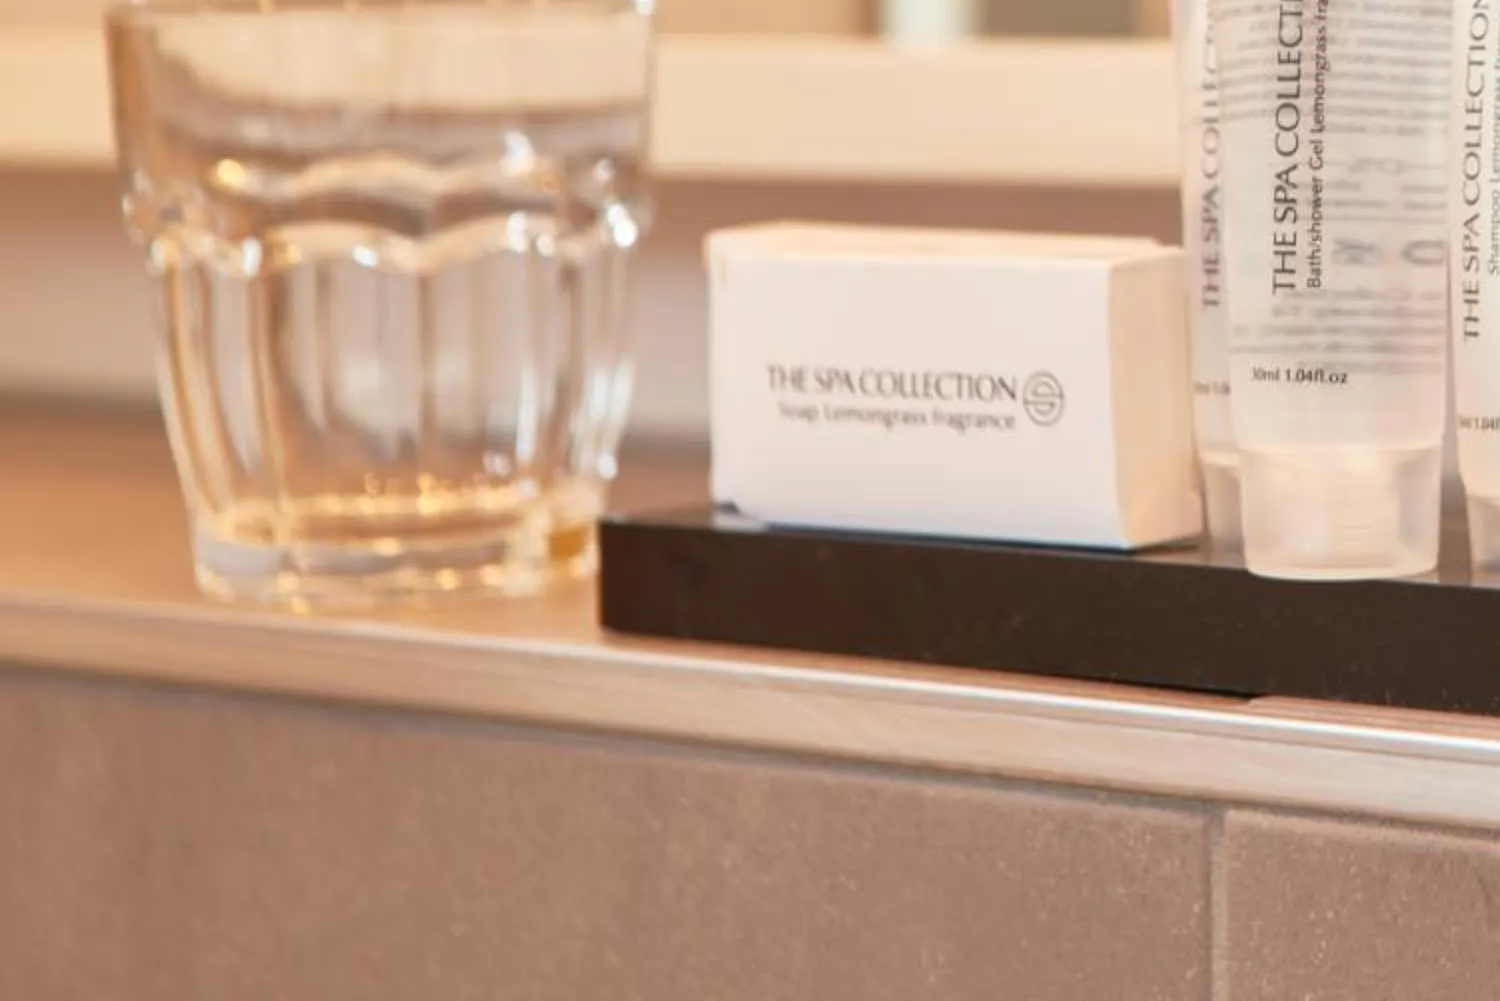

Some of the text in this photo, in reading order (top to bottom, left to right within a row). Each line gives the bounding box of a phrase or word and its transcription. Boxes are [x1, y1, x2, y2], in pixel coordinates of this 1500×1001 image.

[1311, 25, 1331, 132] Lemongrass
[1309, 139, 1324, 171] Gel
[1202, 185, 1221, 244] SPA
[1273, 164, 1299, 224] SPA
[1306, 176, 1323, 288] Bath/shower
[1463, 212, 1481, 273] SPA
[1202, 251, 1220, 310] THE
[1272, 231, 1297, 295] THE
[1463, 280, 1481, 342] THE
[767, 363, 1017, 401] THE SPA COLLECTION
